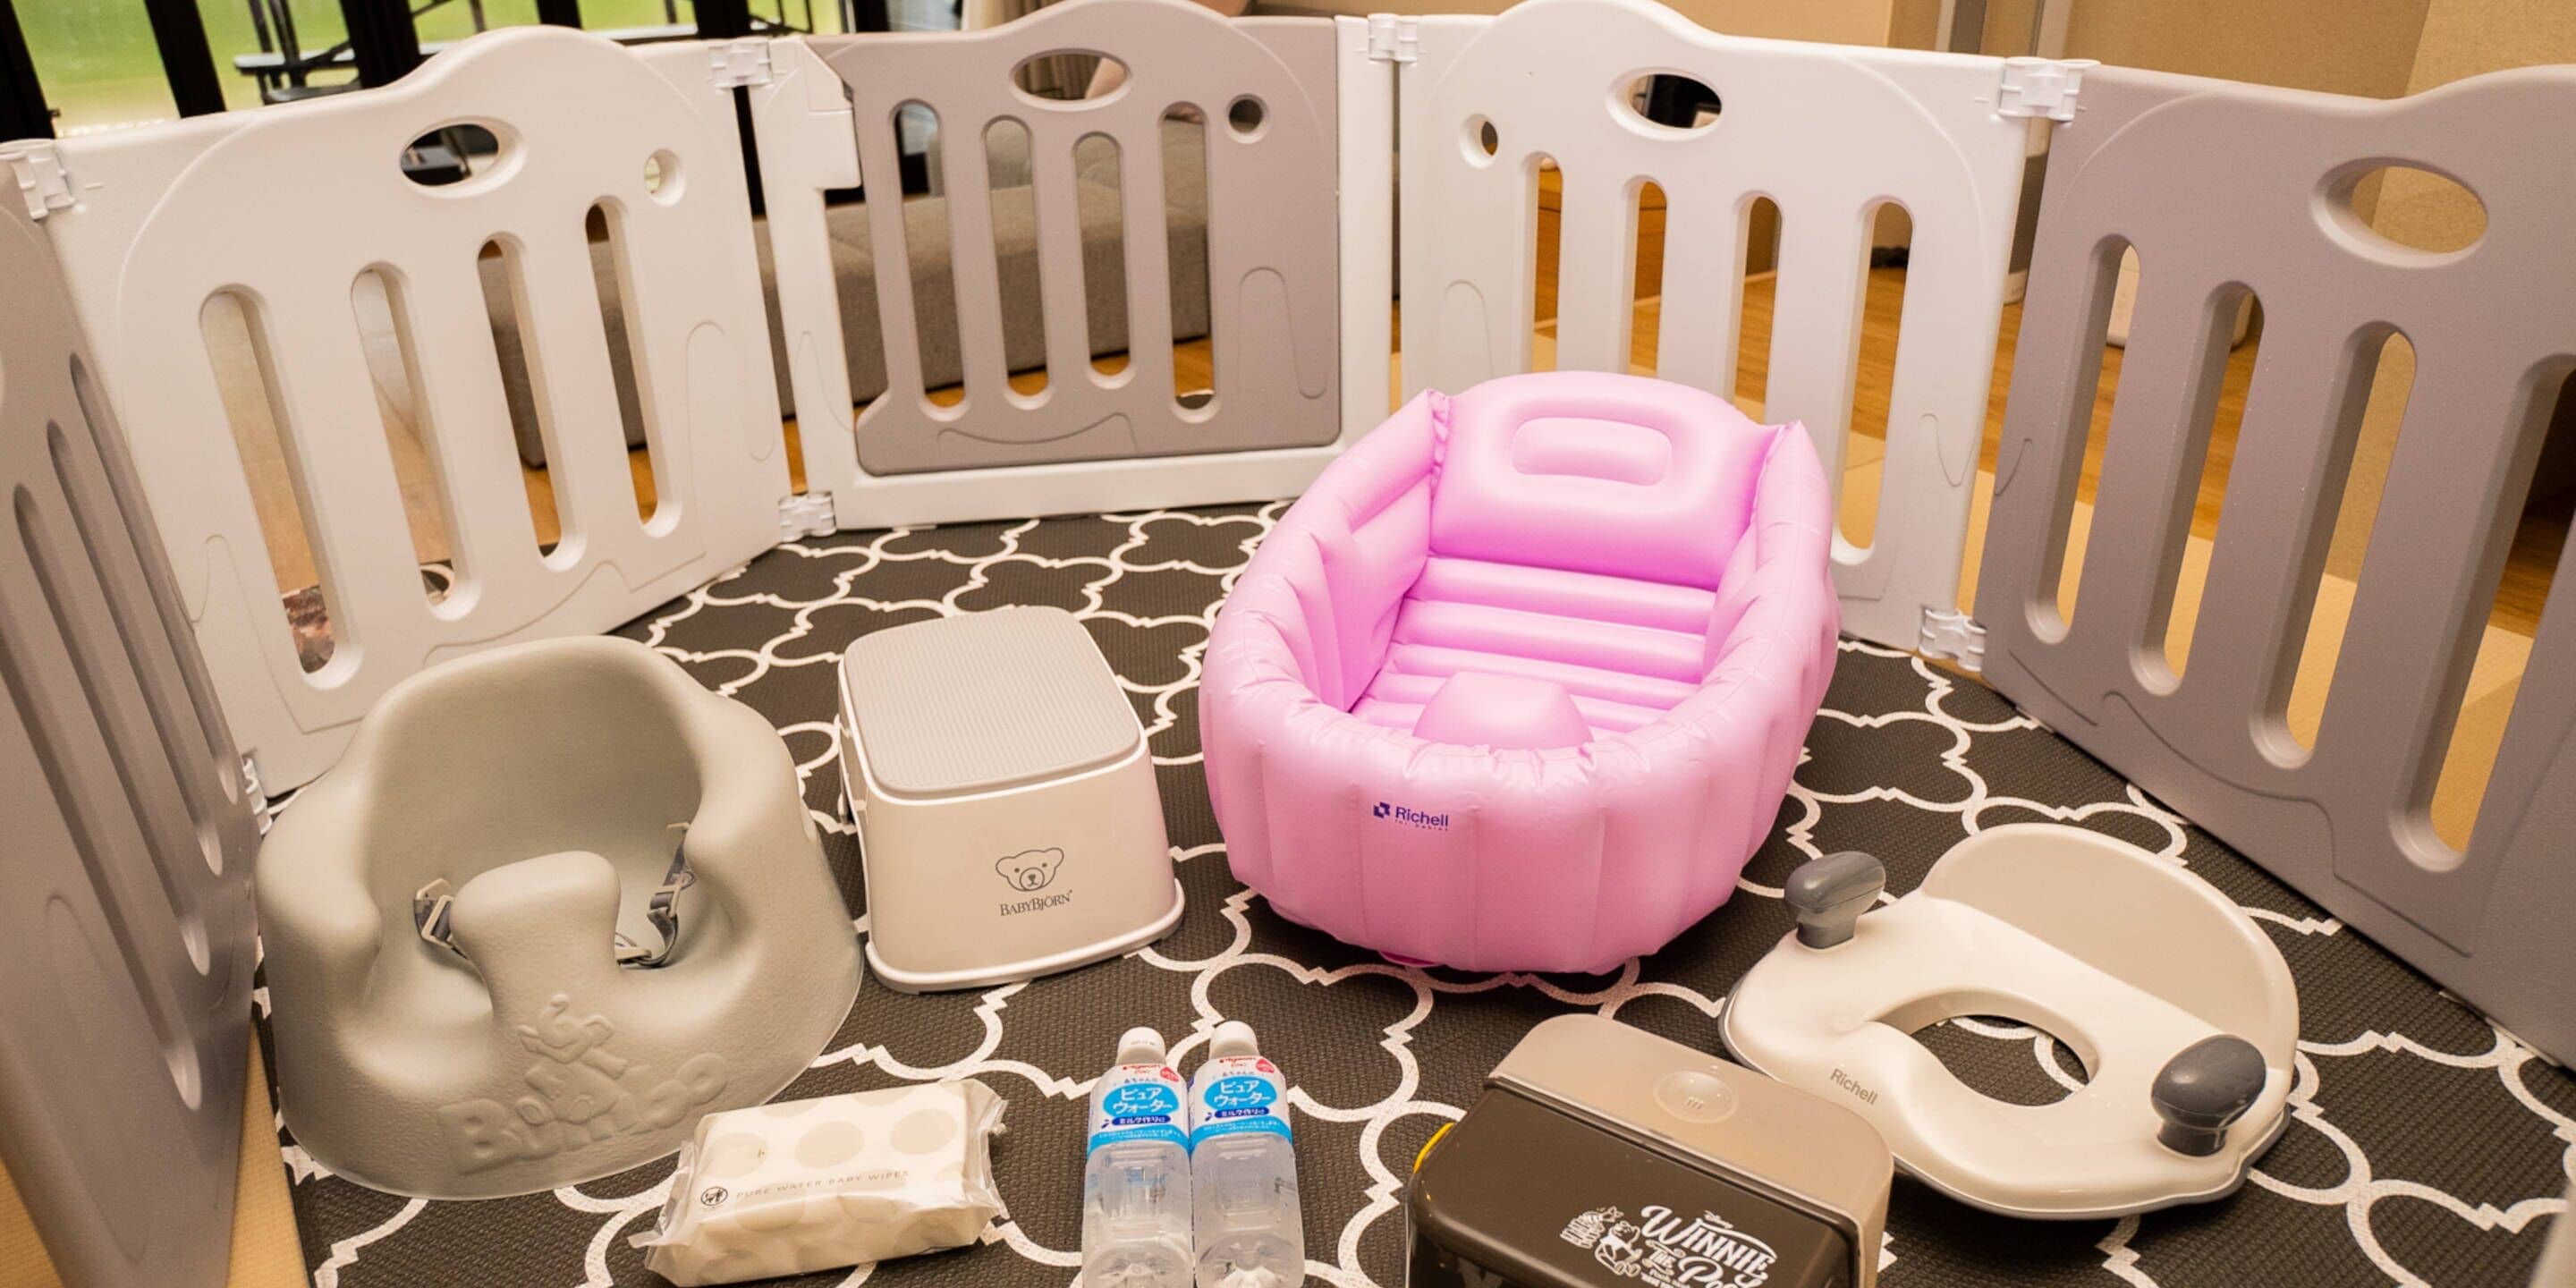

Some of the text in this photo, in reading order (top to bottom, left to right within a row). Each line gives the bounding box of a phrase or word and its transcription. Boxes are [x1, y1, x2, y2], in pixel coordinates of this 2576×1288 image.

[1395, 806, 1449, 827] Richell
[1121, 1087, 1162, 1101] ピュア
[1220, 1080, 1260, 1094] ピュア
[1830, 1068, 1878, 1106] Richell
[1113, 1099, 1173, 1114] ウォーター
[1214, 1092, 1271, 1107] ウォーター
[736, 1170, 909, 1199] PURE WATER BABY WIPES
[1640, 1205, 1776, 1282] WINNIE
[1648, 1249, 1677, 1268] THE
